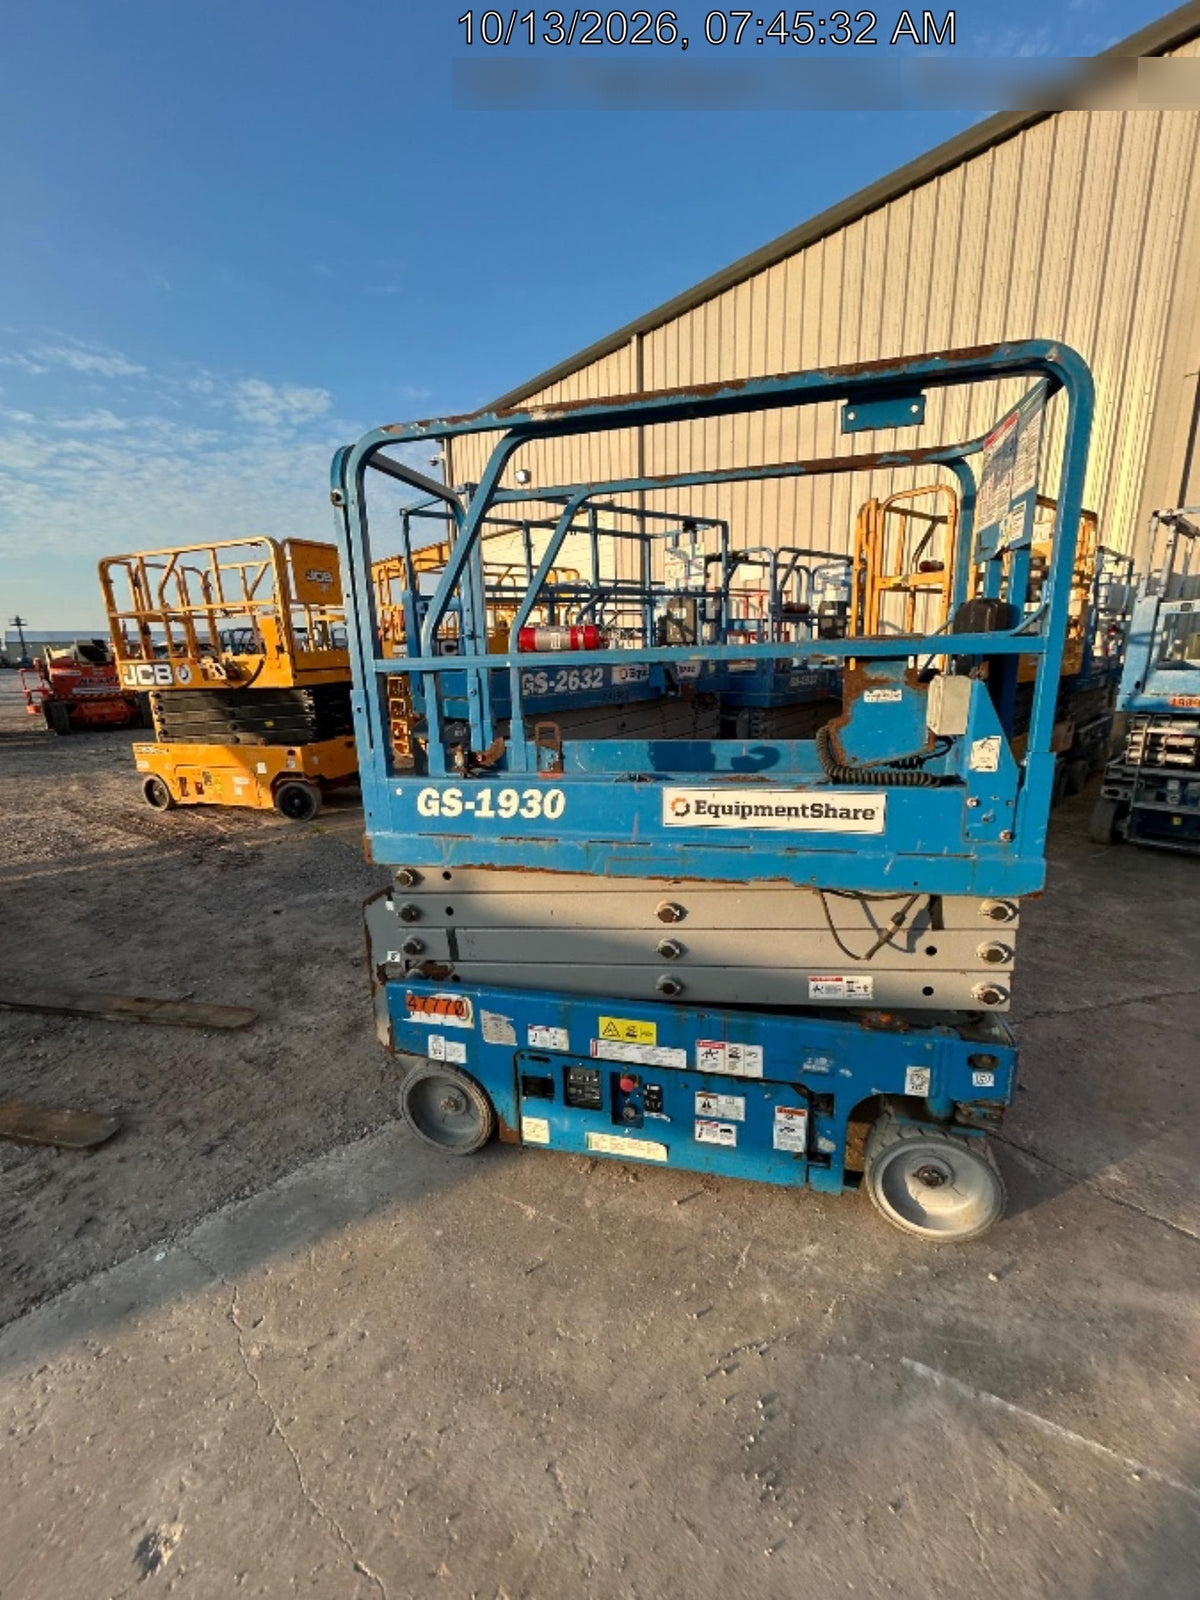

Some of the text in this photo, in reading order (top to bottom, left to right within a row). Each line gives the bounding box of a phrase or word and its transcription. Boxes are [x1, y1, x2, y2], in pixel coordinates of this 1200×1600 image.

[305, 569, 333, 583] JCB
[123, 664, 173, 686] JCB
[521, 667, 603, 695] GS-2632
[417, 787, 566, 819] GS-1930
[694, 798, 876, 822] EquipmentShare
